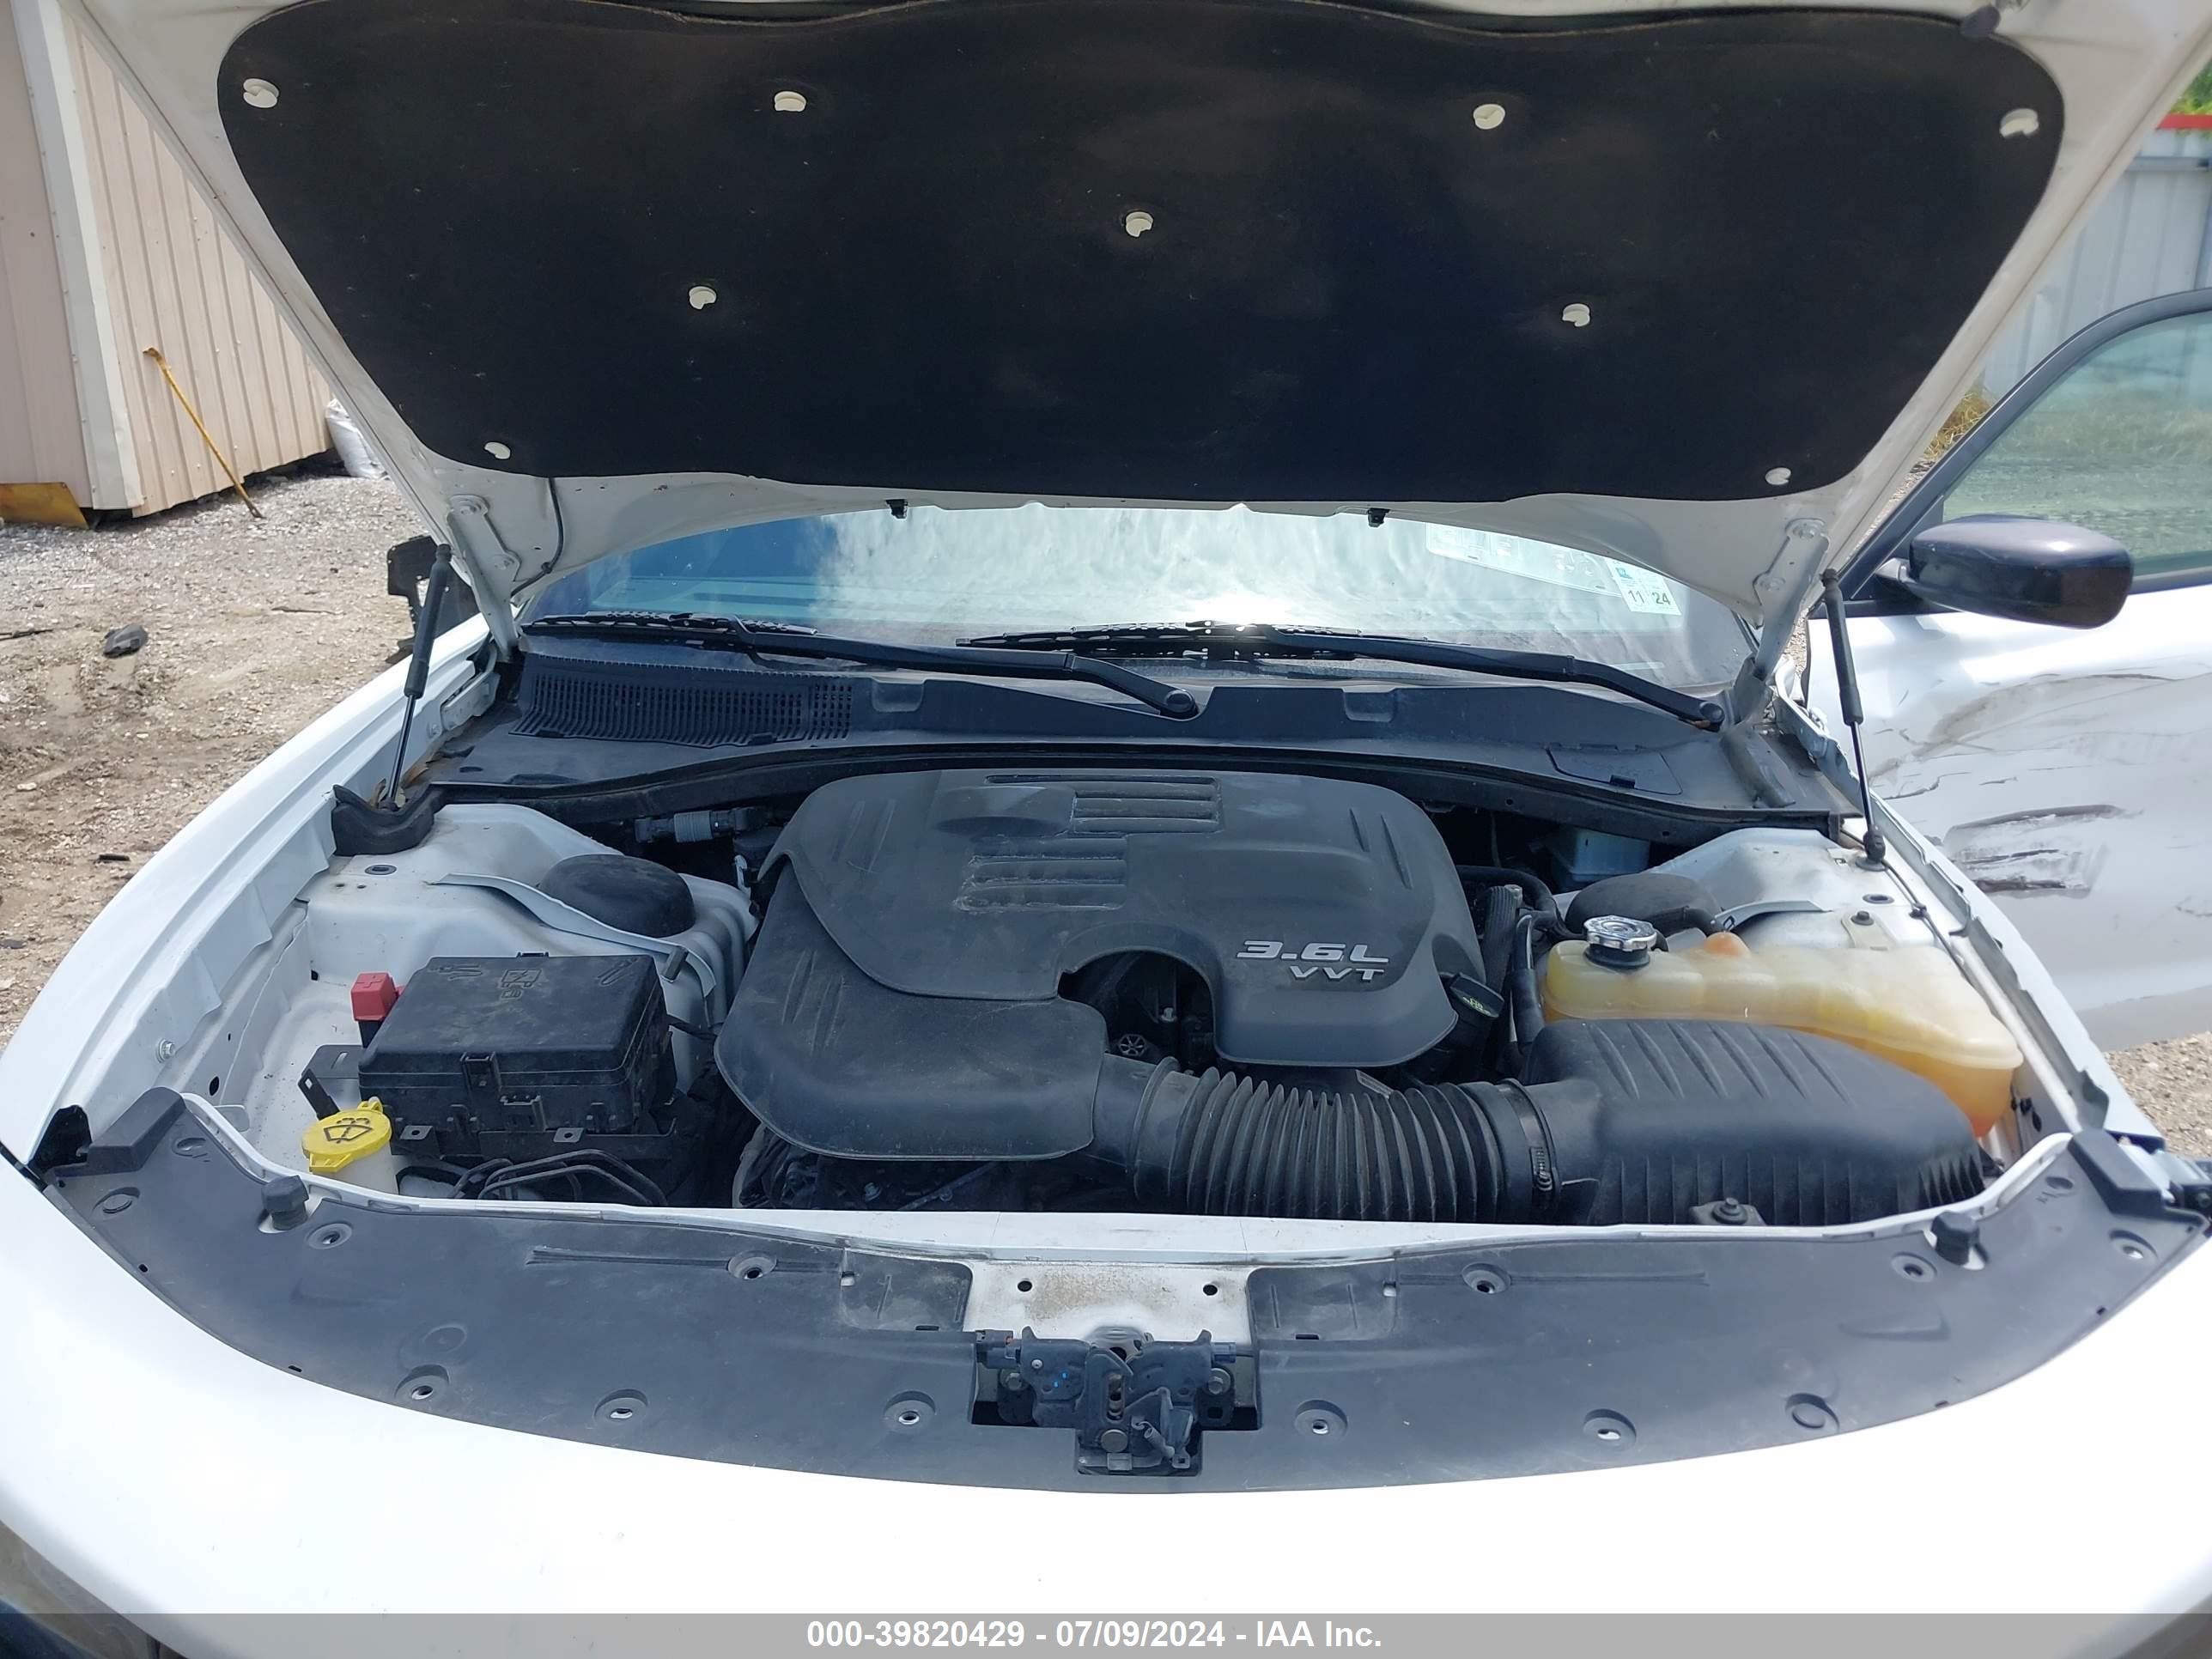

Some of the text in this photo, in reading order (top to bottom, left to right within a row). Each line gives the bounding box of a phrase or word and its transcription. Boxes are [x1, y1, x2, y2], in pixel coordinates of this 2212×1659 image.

[1627, 589, 1671, 605] 11 24
[1237, 940, 1389, 963] 3.6L
[1289, 965, 1385, 981] VVT
